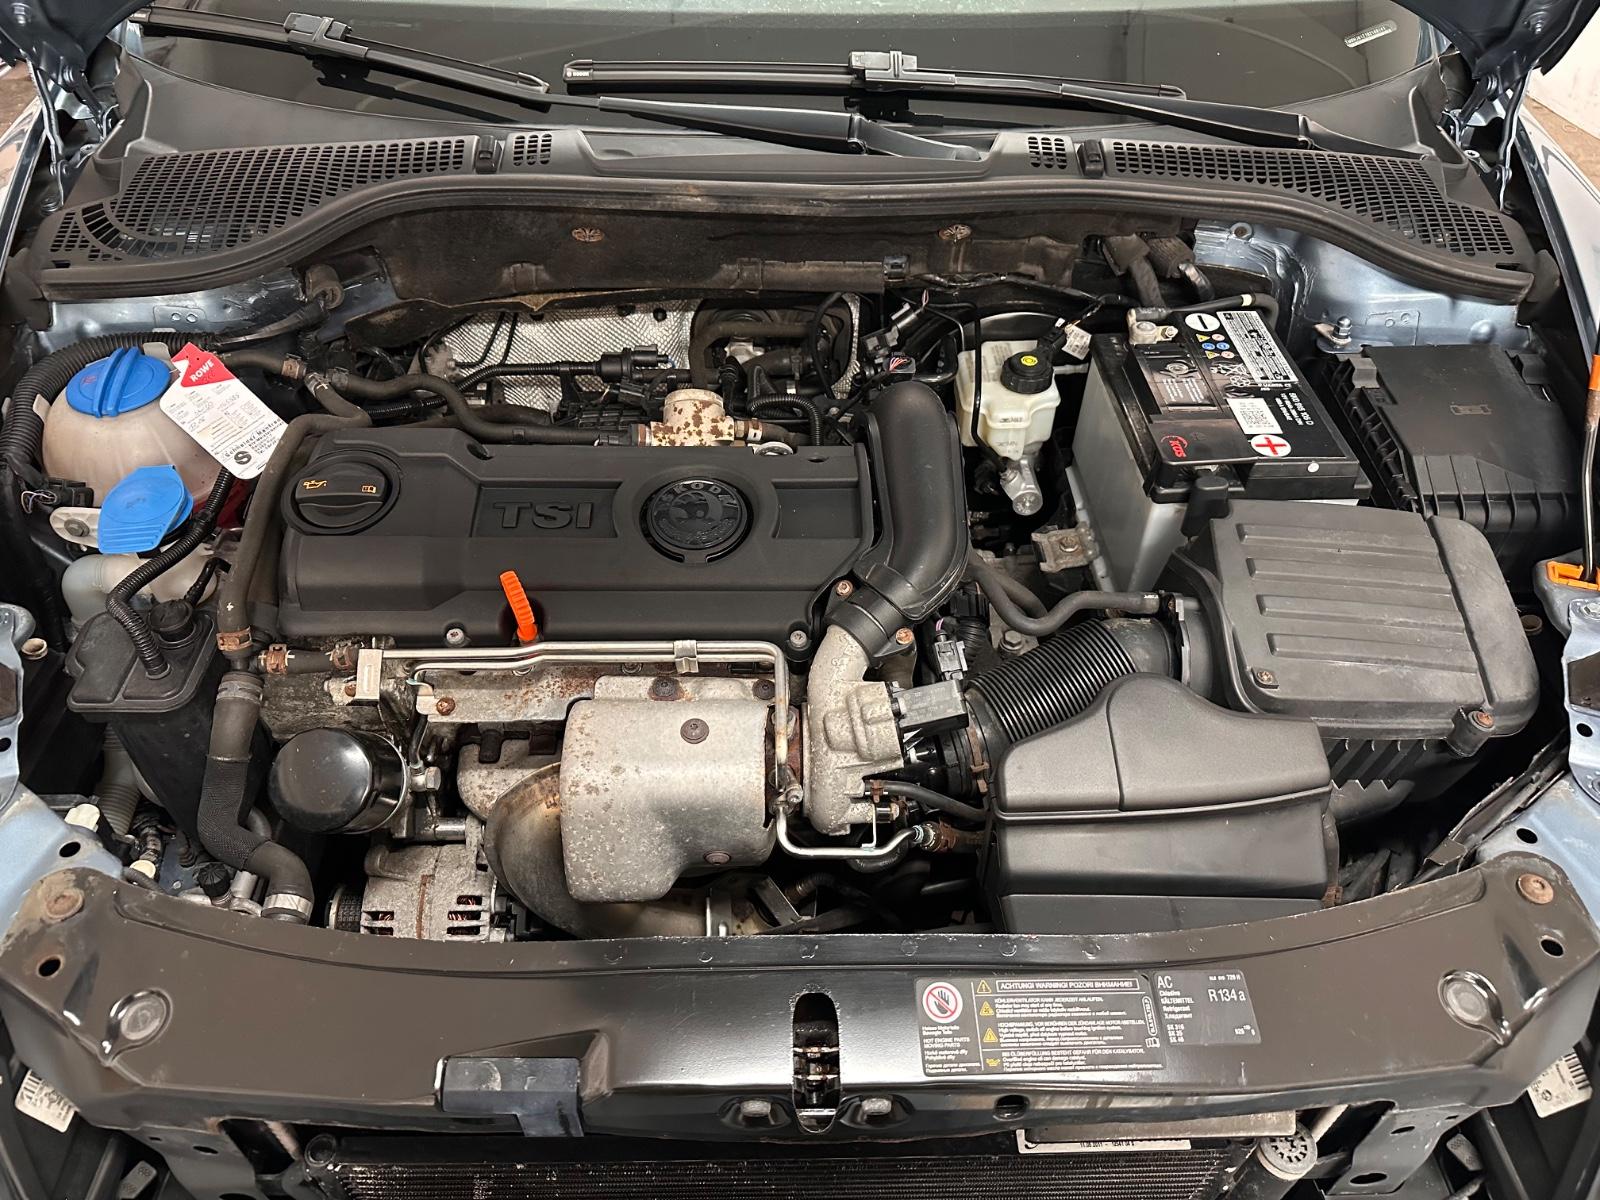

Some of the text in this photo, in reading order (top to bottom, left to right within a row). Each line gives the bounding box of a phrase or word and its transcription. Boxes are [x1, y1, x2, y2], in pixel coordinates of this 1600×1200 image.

[190, 359, 214, 382] ROWE
[493, 502, 594, 530] TSI
[1157, 975, 1173, 989] AC
[1207, 988, 1218, 1002] R
[1218, 988, 1238, 1002] 134
